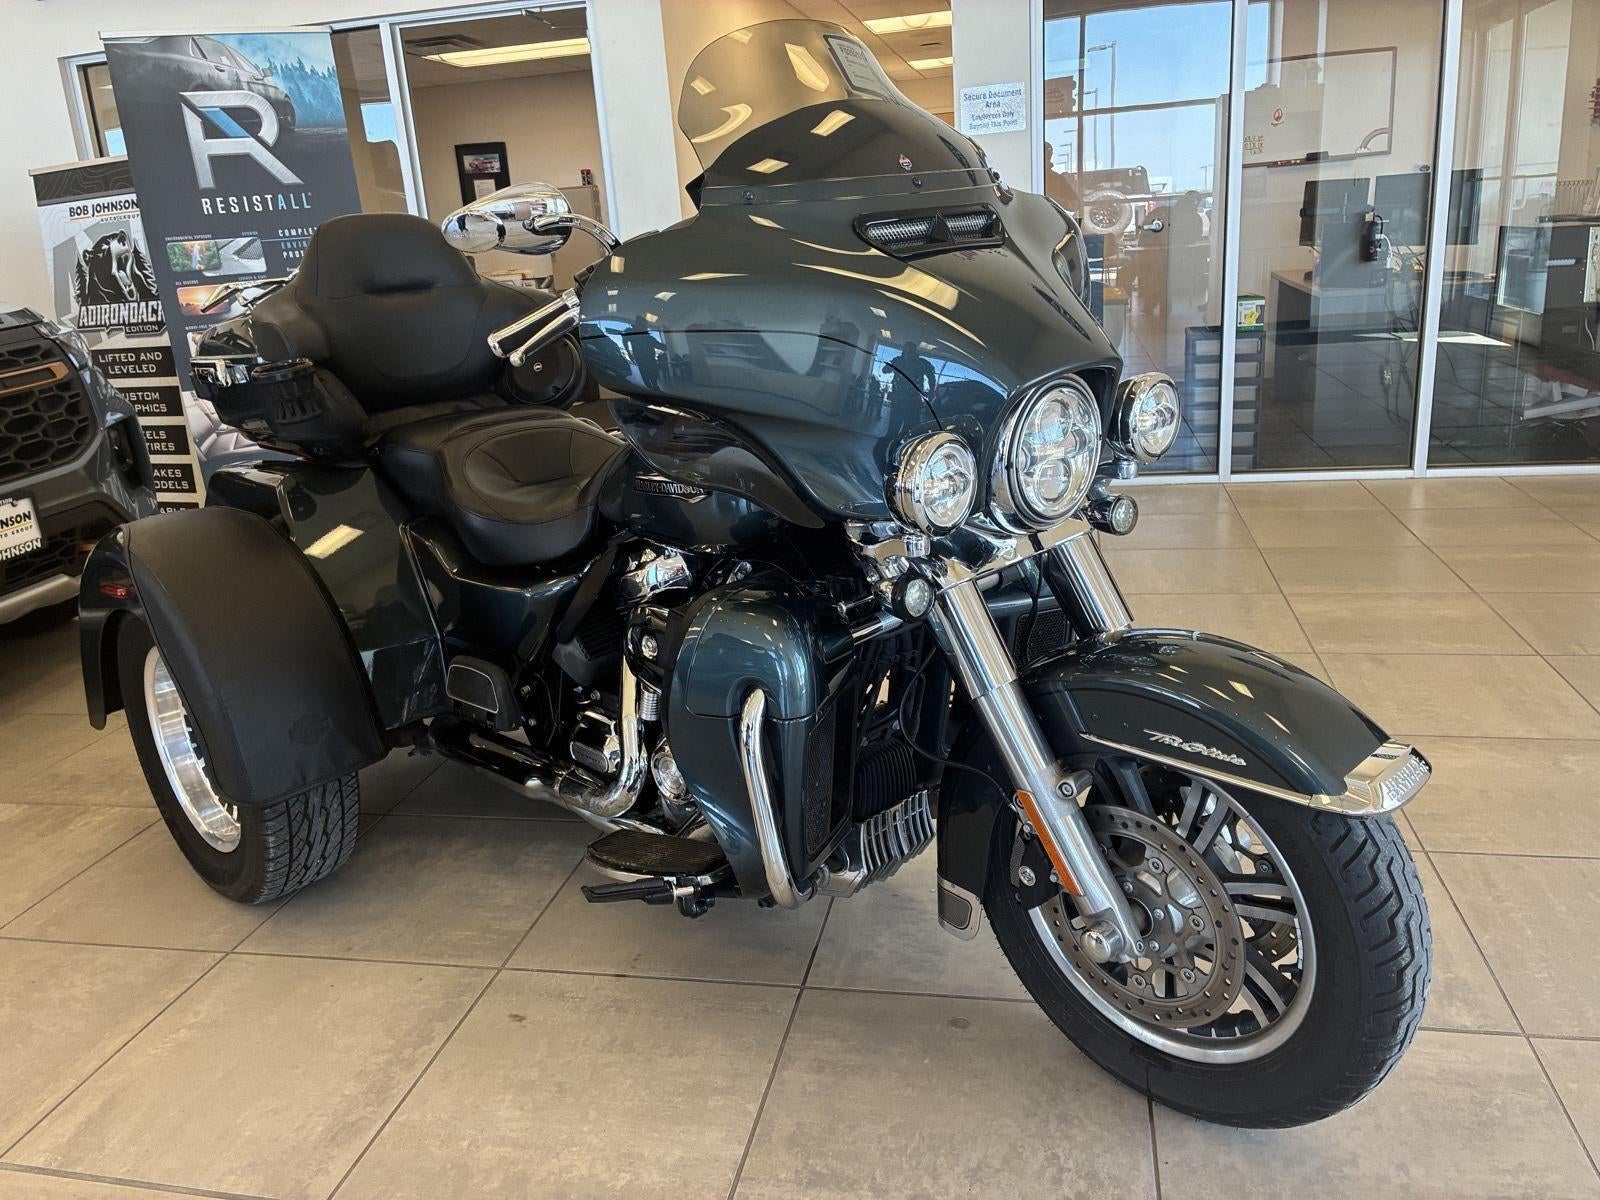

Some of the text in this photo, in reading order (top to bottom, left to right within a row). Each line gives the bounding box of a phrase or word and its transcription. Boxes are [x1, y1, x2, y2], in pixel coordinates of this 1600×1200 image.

[963, 89, 1022, 102] Secure Document
[69, 199, 139, 217] BOB JOHNSON
[281, 239, 308, 249] ENVIR
[283, 250, 304, 259] PROT
[79, 300, 166, 327] ADIRONDACK
[126, 325, 159, 333] EDITION
[99, 352, 163, 363] LIFTED AND
[108, 364, 157, 374] LEVELED
[122, 392, 160, 401] USTOM
[134, 404, 168, 413] PHICS
[144, 431, 167, 439] ELS
[153, 469, 182, 478] AKES
[155, 481, 189, 489] ODELS
[0, 538, 42, 560] HNSON
